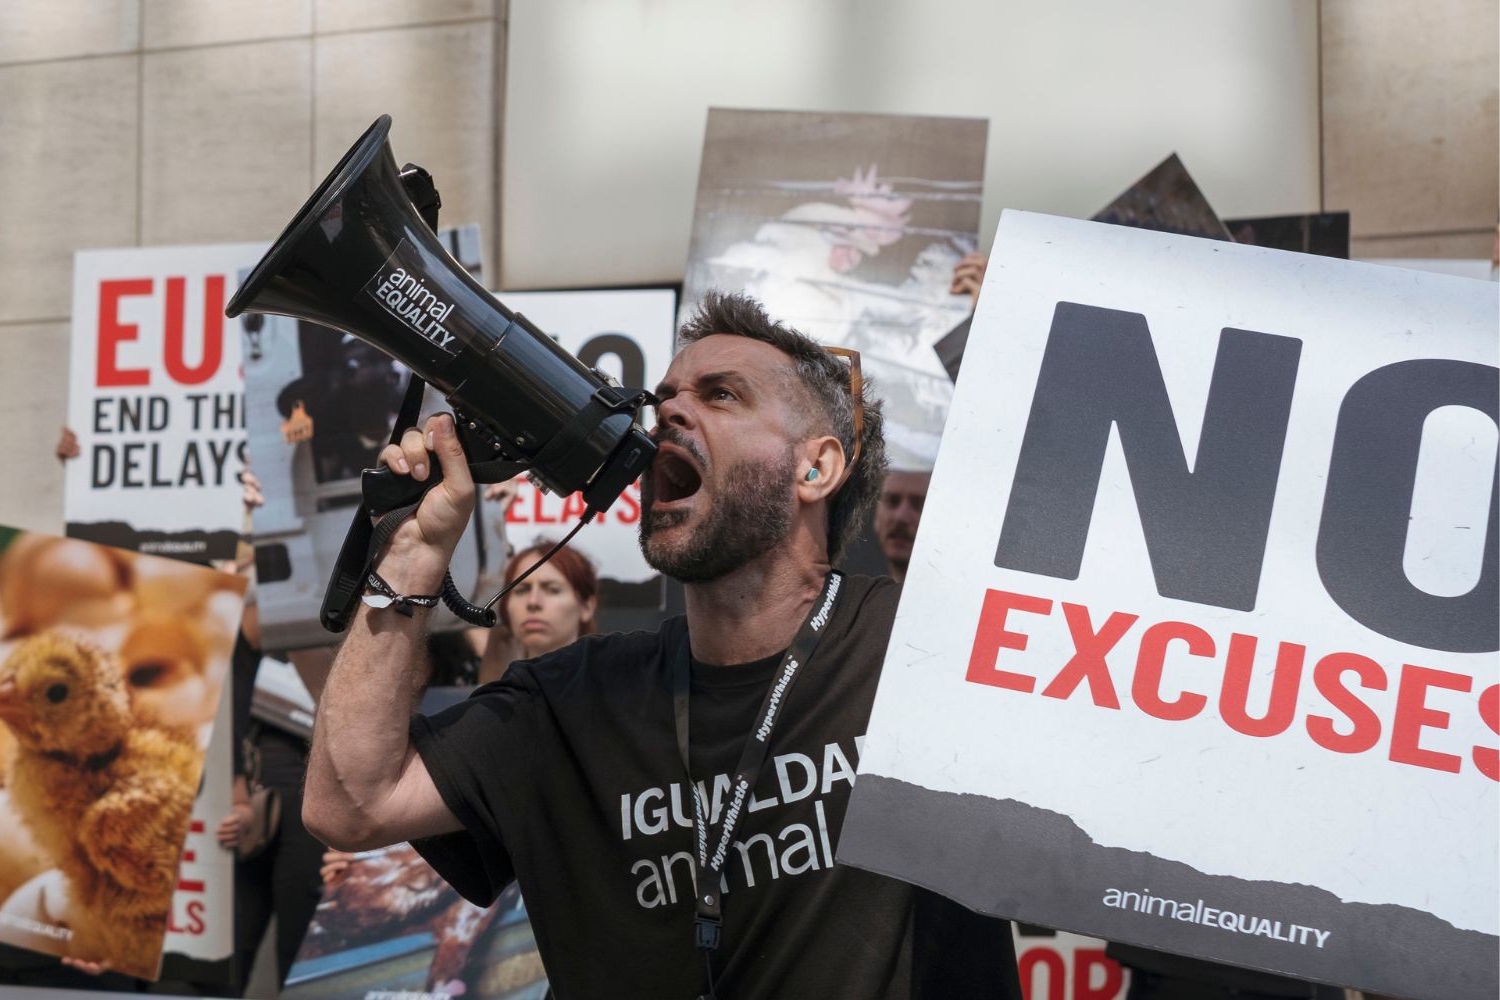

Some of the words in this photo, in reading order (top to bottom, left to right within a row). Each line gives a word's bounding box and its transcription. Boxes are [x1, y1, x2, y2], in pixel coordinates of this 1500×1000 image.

[375, 280, 456, 347] EQUALITY
[389, 267, 455, 323] animal
[92, 395, 170, 434] END
[505, 476, 642, 524] ELAS
[994, 301, 1500, 653] NO
[620, 735, 866, 841] IGUALDA
[631, 800, 835, 909] anmal
